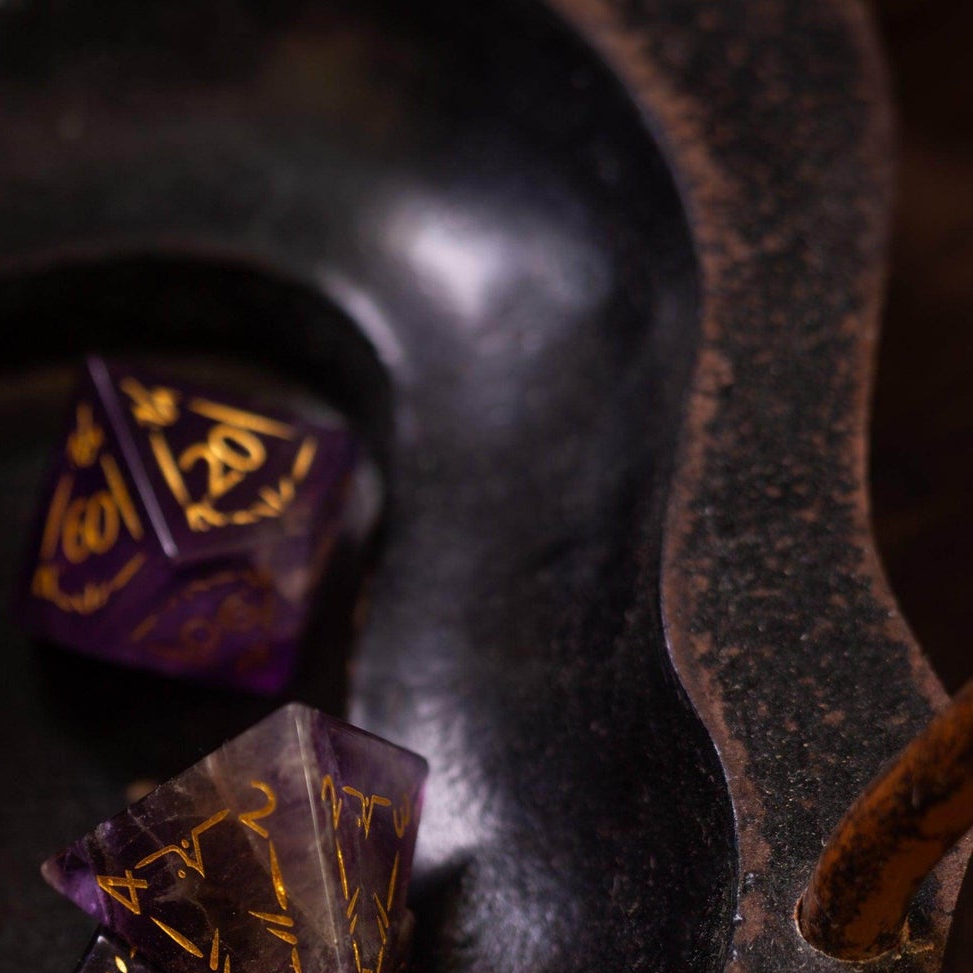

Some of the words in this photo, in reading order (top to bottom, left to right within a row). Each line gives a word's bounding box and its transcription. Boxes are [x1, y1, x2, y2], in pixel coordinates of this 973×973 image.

[179, 424, 267, 499] 20
[238, 780, 276, 839] 2
[96, 869, 148, 915] 4
